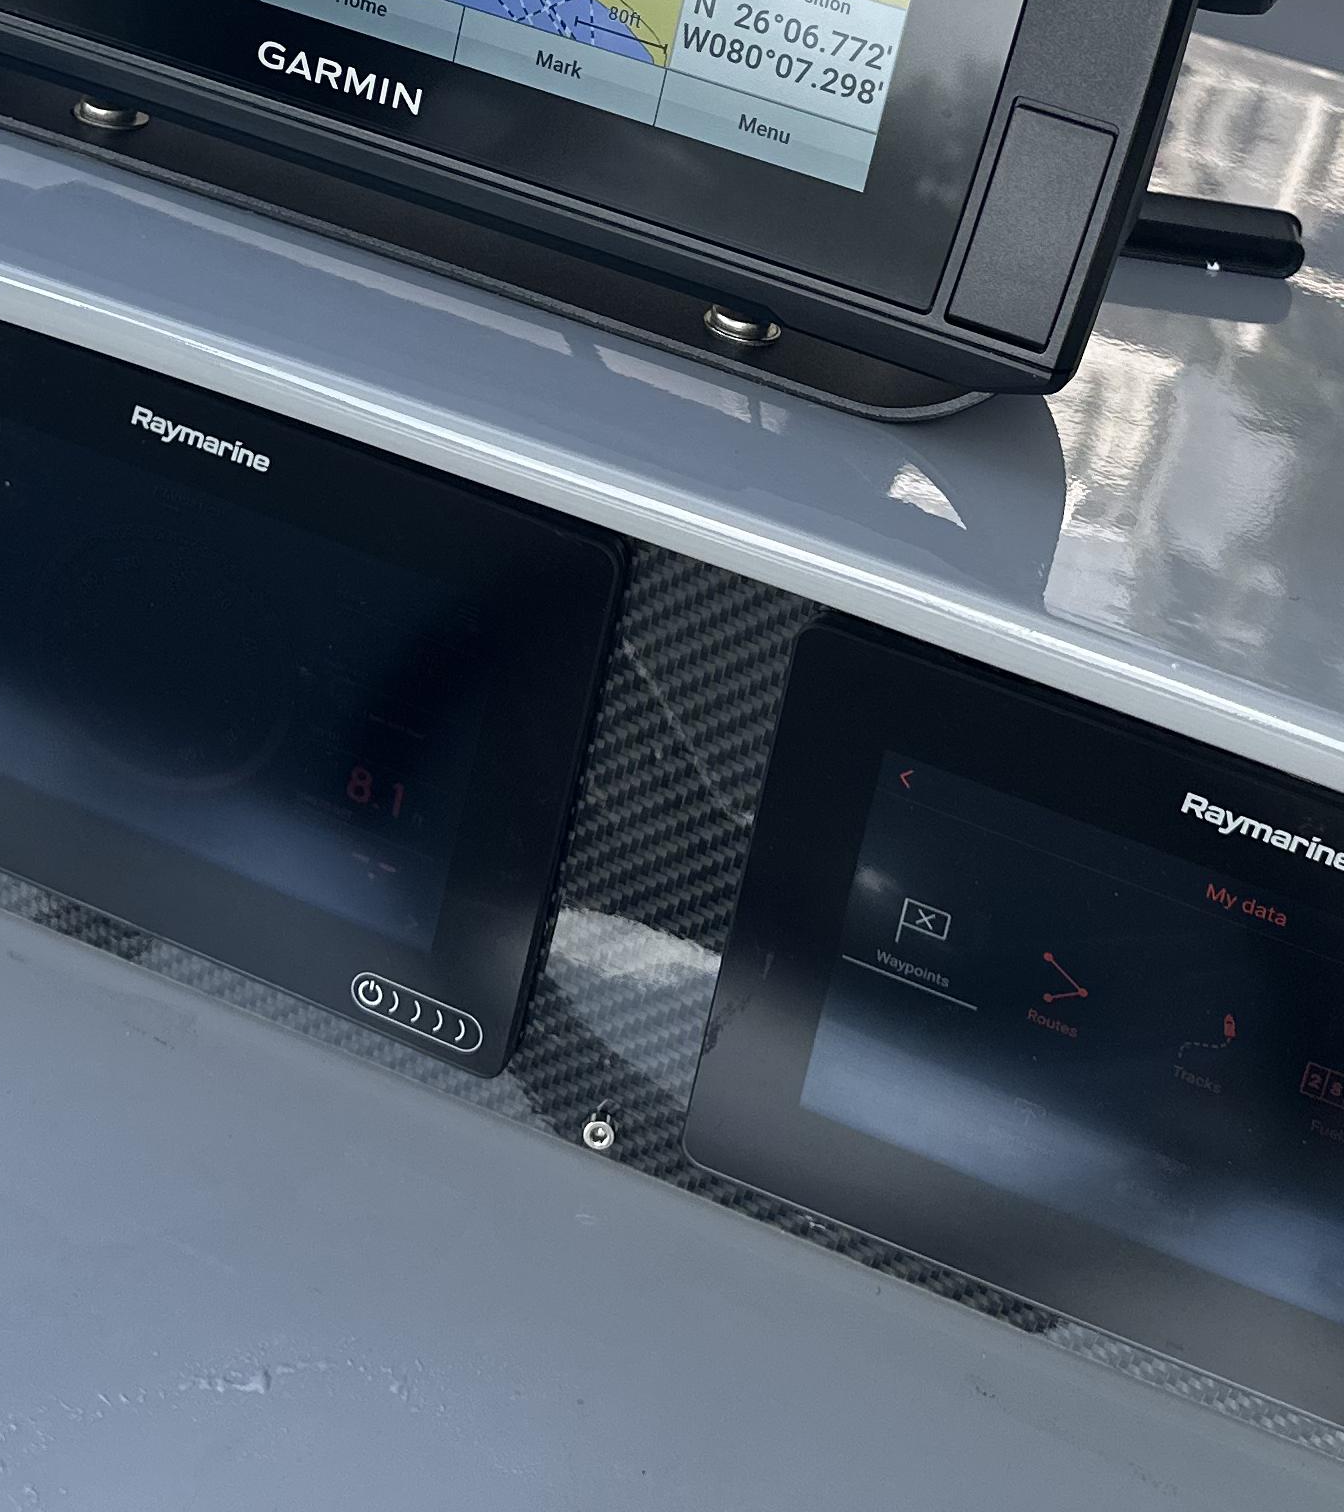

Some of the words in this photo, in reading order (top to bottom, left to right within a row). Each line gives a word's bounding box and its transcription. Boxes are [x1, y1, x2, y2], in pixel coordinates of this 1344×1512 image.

[608, 5, 642, 29] 80ft
[733, 2, 894, 72] 26°06.772'
[257, 41, 423, 116] GARMIN
[535, 49, 582, 80] Mark
[682, 21, 885, 105] W080°07.298'
[737, 113, 791, 145] Menu
[131, 404, 271, 473] Raymarine
[1206, 883, 1237, 910] My
[1241, 899, 1288, 927] data
[876, 949, 950, 989] Waypoints
[1027, 1007, 1079, 1038] Routes
[1173, 1064, 1223, 1095] Tracks
